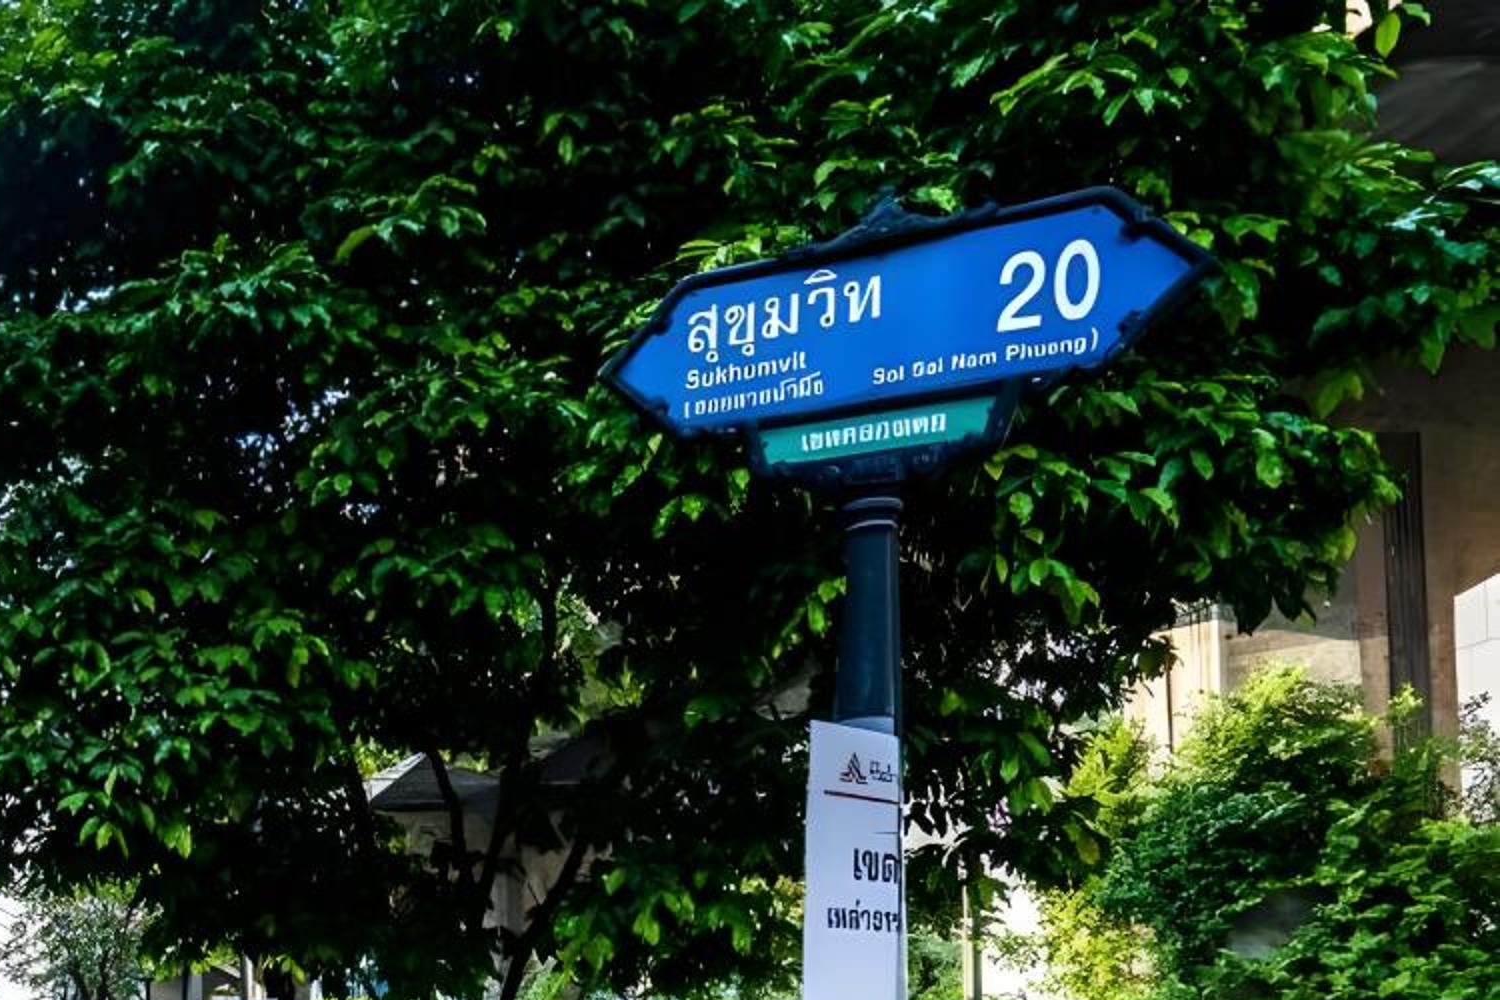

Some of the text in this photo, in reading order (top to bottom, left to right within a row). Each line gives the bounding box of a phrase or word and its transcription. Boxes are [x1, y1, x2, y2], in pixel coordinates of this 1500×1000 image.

[687, 269, 882, 362] สุขุมวิท
[997, 239, 1101, 333] 20
[685, 352, 807, 389] Sukhumvit
